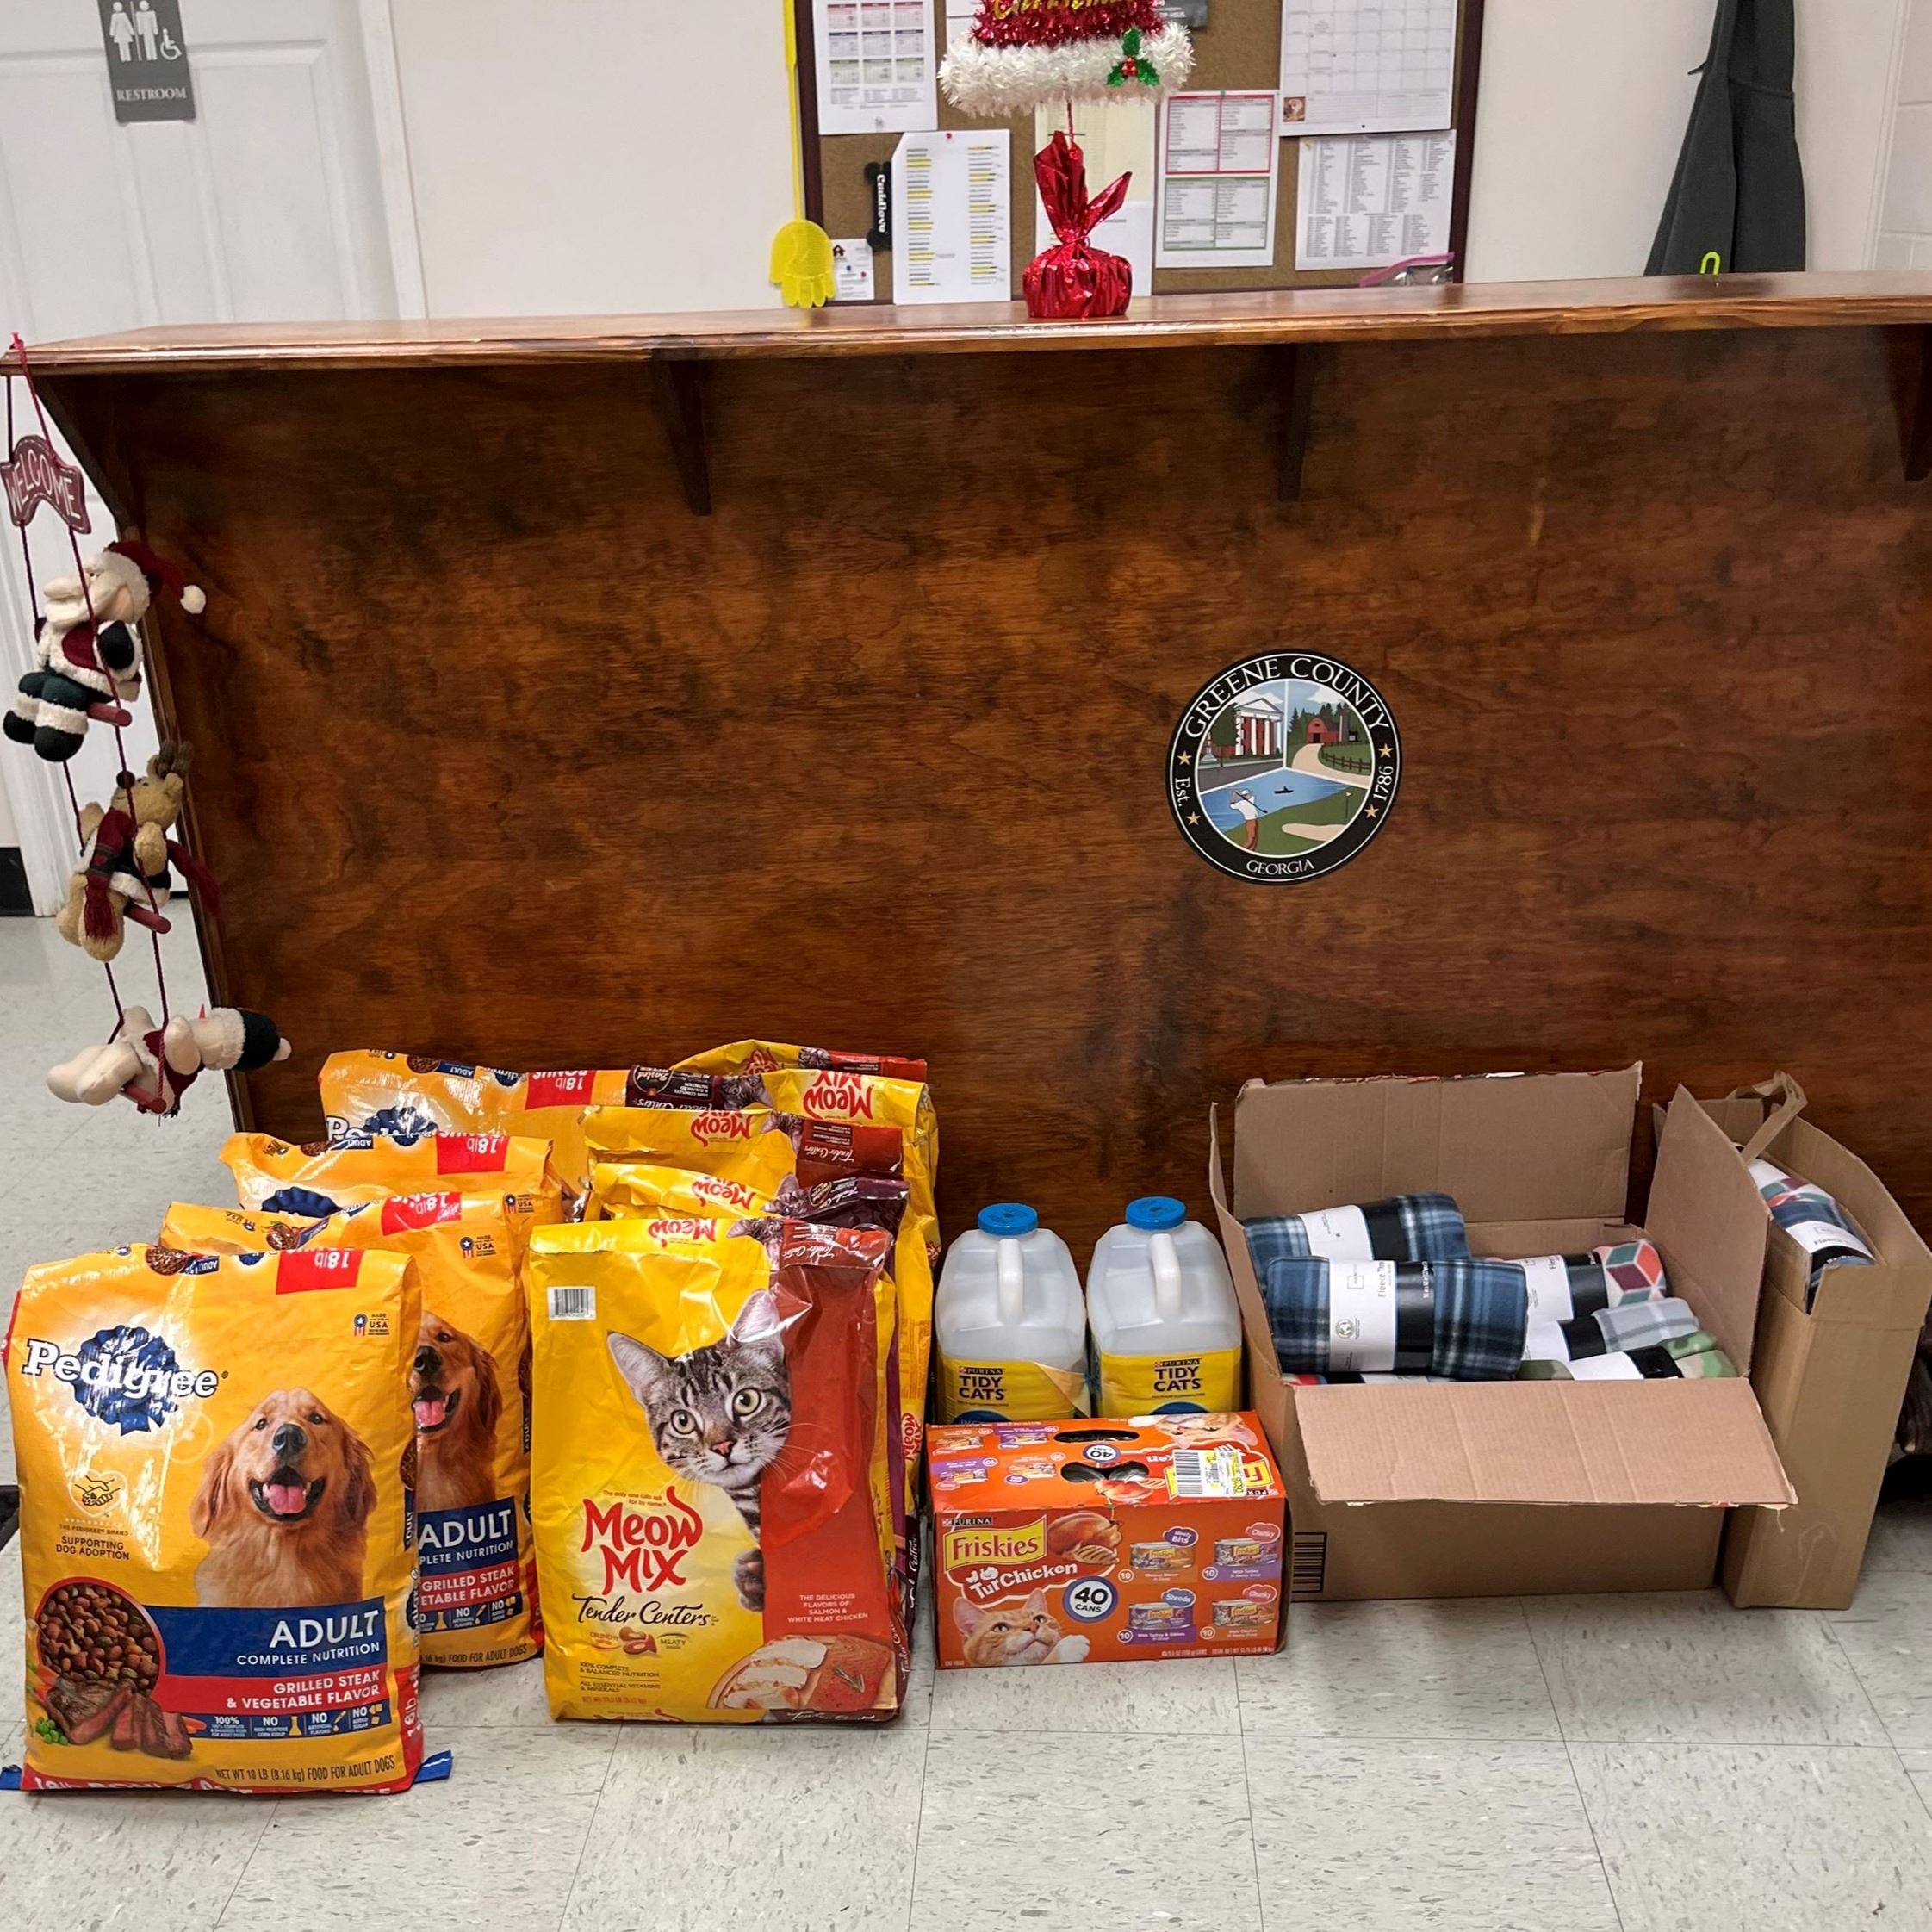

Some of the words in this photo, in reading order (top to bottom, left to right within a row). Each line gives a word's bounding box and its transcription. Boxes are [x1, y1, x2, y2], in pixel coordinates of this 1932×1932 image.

[116, 88, 187, 102] RESTROOM
[6, 449, 82, 519] WELCOME
[1185, 658, 1282, 738] GREENE
[1290, 657, 1390, 730] COUNTY
[1175, 776, 1191, 807] Est.
[1373, 765, 1394, 802] 1786
[1246, 859, 1315, 875] GEORGIA
[803, 1084, 873, 1120] Meow
[690, 1115, 751, 1147] Meow
[691, 1181, 755, 1210] Meow
[649, 1218, 716, 1248] Meow
[1377, 1274, 1387, 1298] Fleece
[22, 1339, 218, 1398] Pedigree
[1155, 1366, 1199, 1379] TIDY
[959, 1375, 1002, 1388] TIDY
[1154, 1378, 1202, 1392] CATS
[959, 1388, 1004, 1400] CATS
[902, 1413, 915, 1462] Meow
[419, 1509, 511, 1550] ADULT
[581, 1486, 703, 1552] Meow
[56, 1544, 77, 1554] DOG
[79, 1547, 129, 1560] ADOPTION
[61, 1536, 124, 1550] SUPPORTING
[419, 1555, 451, 1565] PLETE
[457, 1540, 513, 1561] NUTRITION
[952, 1535, 1039, 1561] Friskies
[422, 1575, 475, 1592] GRILLED
[479, 1564, 515, 1583] STEAK
[420, 1590, 466, 1606] ETABLE
[470, 1579, 514, 1600] FLAVOR
[816, 1593, 855, 1601] DELICIOUS
[1074, 1587, 1109, 1605] 40
[1165, 1593, 1191, 1603] Shreds
[456, 1608, 470, 1618] NO
[492, 1600, 505, 1611] NO
[571, 1593, 637, 1624] Tender
[639, 1601, 711, 1627] Centers
[835, 1612, 869, 1621] CHICKEN
[1075, 1604, 1102, 1613] CANS
[269, 1610, 379, 1649] ADULT
[237, 1654, 308, 1665] COMPLETE
[312, 1642, 380, 1662] NUTRITION
[448, 1654, 468, 1663] FOOD
[469, 1652, 483, 1662] FOR
[485, 1649, 507, 1661] ADULT
[508, 1643, 528, 1657] DOGS
[273, 1678, 334, 1694] GRILLED
[339, 1669, 380, 1687] STEAK
[586, 1668, 620, 1676] BALANCED
[227, 1698, 238, 1709] &
[242, 1693, 322, 1709] VEGETABLE
[327, 1686, 380, 1705] FLAVOR
[214, 1716, 240, 1724] 100%
[263, 1717, 278, 1726] NO
[312, 1712, 327, 1724] NO
[352, 1706, 368, 1718] NO
[216, 1769, 231, 1780] NET
[233, 1769, 245, 1780] WT
[258, 1769, 269, 1780] LB
[293, 1768, 305, 1782] kg)
[308, 1767, 327, 1780] FOOD
[331, 1766, 346, 1779] FOR
[348, 1761, 373, 1777] ADULT
[374, 1755, 395, 1773] DOGS
